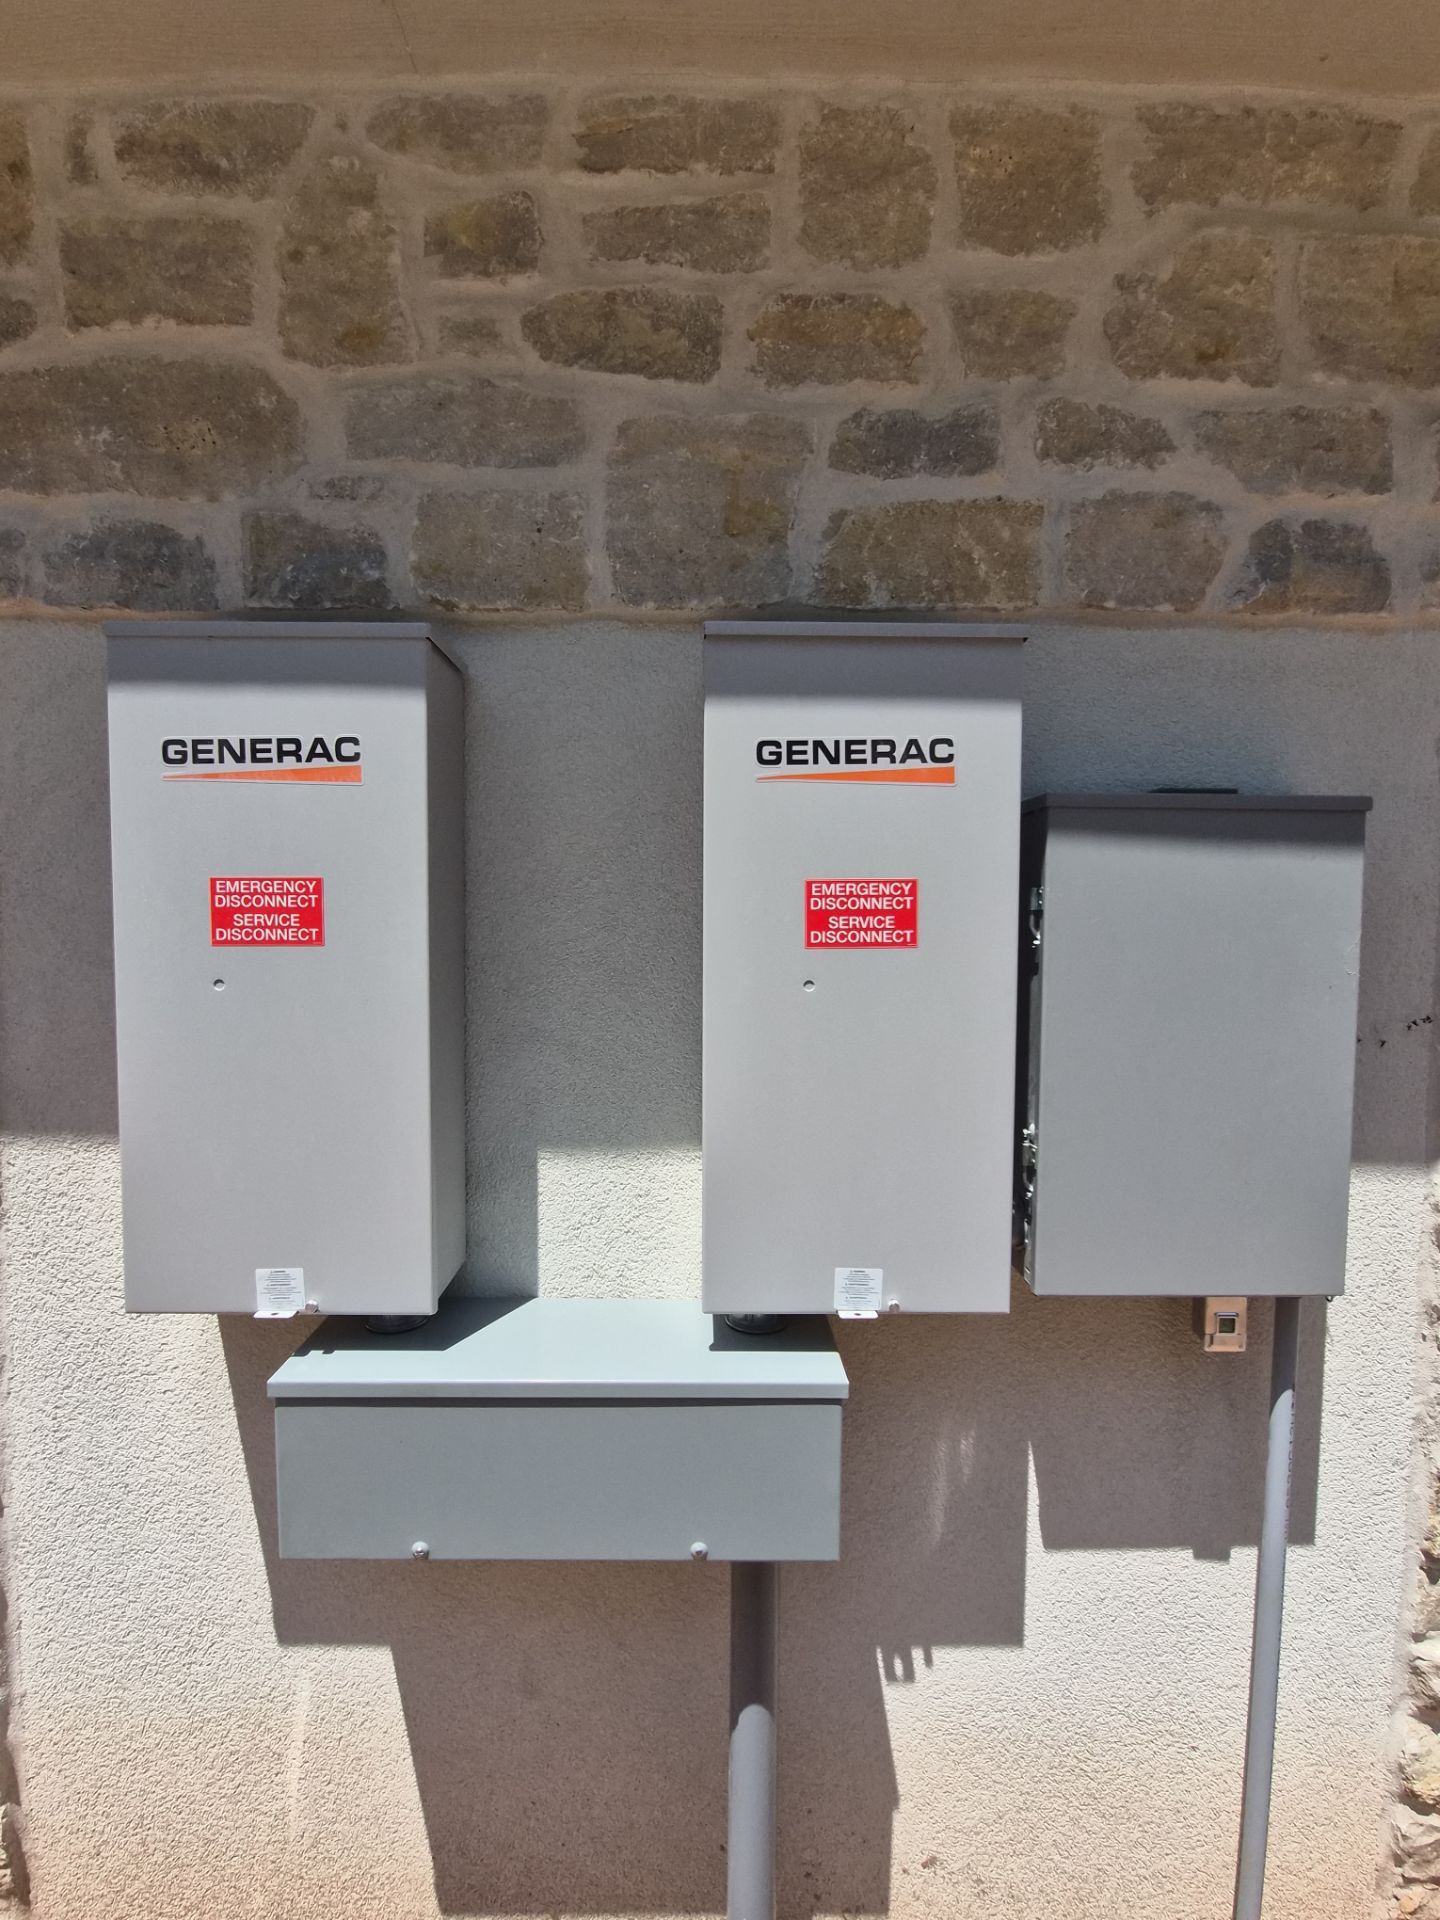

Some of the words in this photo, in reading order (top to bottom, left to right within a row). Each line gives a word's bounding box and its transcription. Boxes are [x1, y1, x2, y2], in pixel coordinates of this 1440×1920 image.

[162, 737, 361, 765] GENERAC
[756, 738, 954, 766] GENERAC
[216, 880, 317, 893] EMERGENCY
[811, 883, 912, 895] EMERGENCY
[214, 895, 318, 908] DISCONNECT
[810, 897, 914, 910] DISCONNECT
[233, 913, 300, 926] SERVICE
[828, 916, 896, 929] SERVICE
[215, 928, 319, 941] DISCONNECT
[810, 930, 914, 943] DISCONNECT
